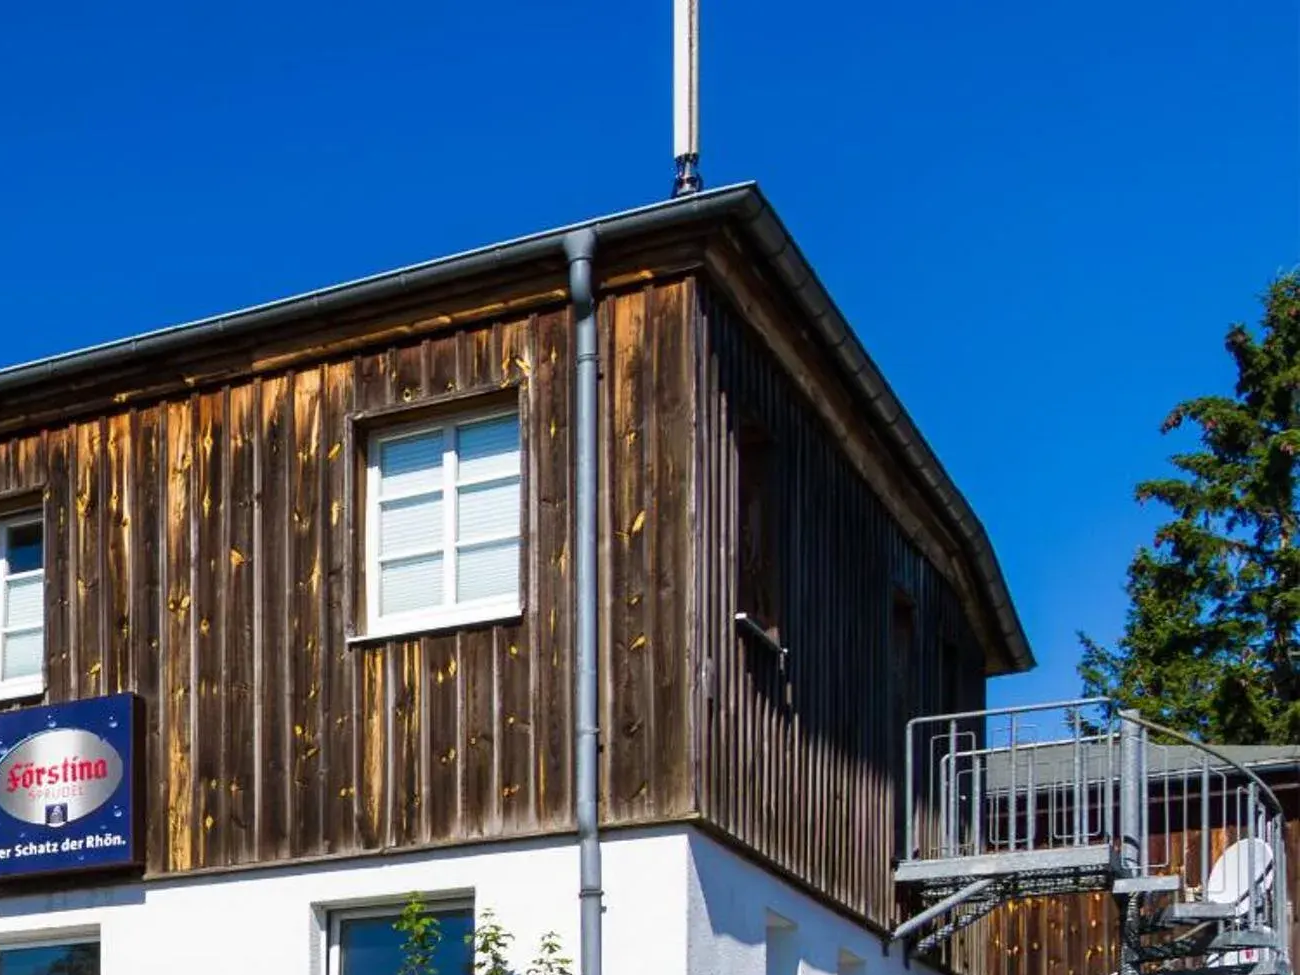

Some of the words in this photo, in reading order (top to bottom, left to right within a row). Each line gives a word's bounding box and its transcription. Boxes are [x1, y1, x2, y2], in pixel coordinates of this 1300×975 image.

[6, 755, 108, 794] Förstina
[14, 841, 60, 857] Schatz
[61, 838, 84, 852] der
[86, 833, 127, 849] Rhön.
